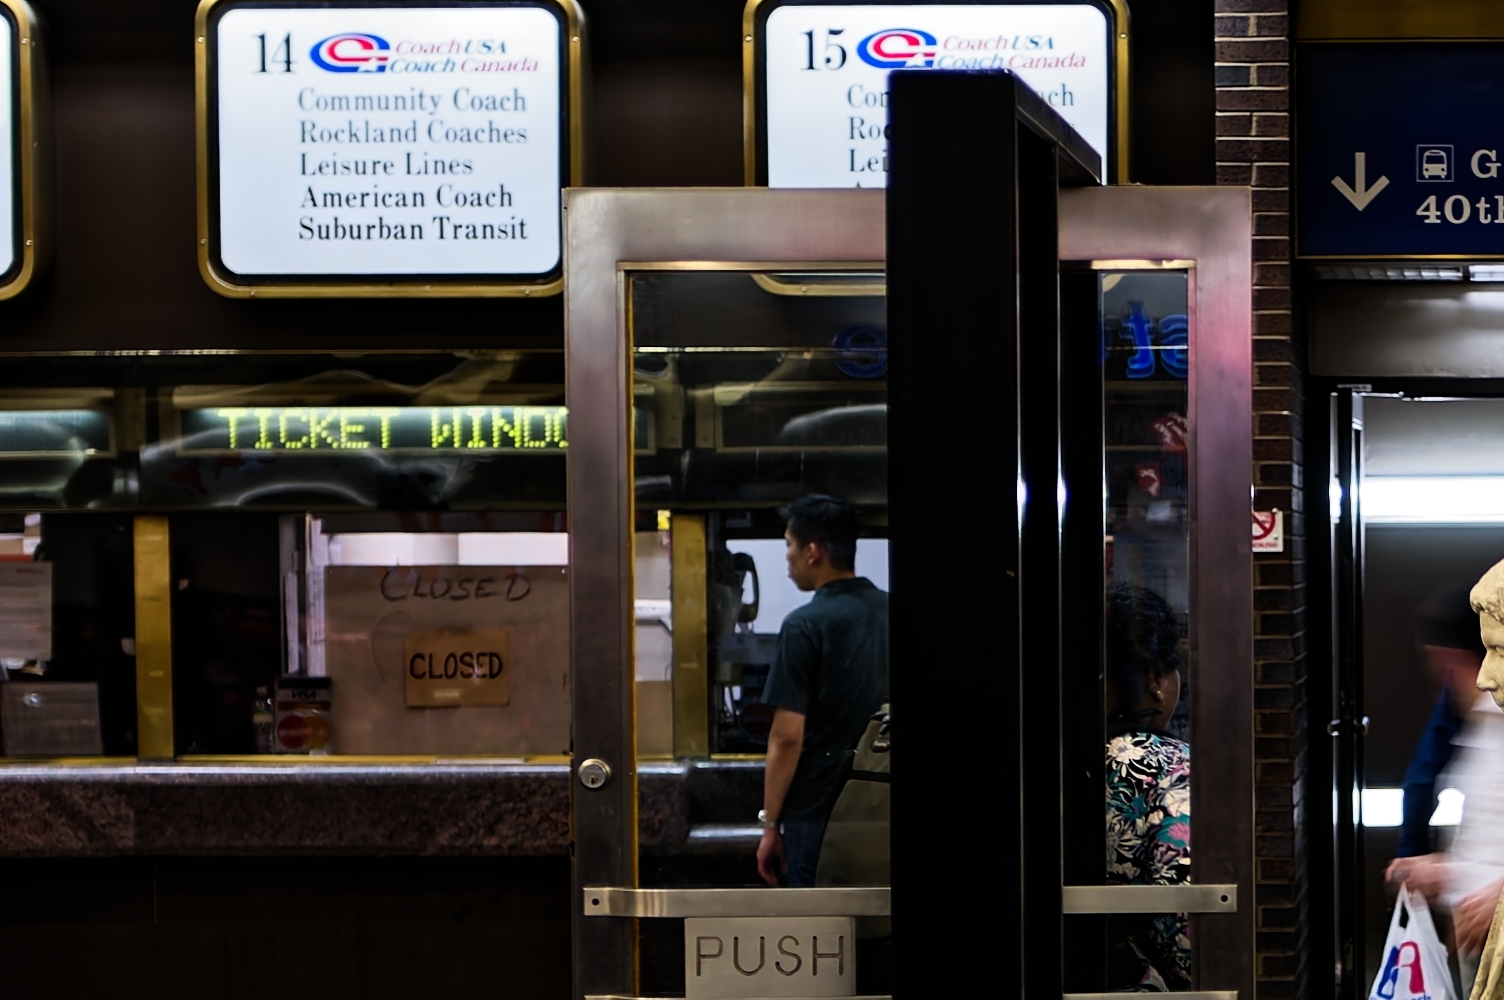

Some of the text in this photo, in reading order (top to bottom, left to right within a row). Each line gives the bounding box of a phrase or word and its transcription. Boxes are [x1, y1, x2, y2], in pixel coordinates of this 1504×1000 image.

[252, 32, 298, 74] 14
[395, 39, 508, 54] Coach USA
[800, 28, 847, 71] 15
[943, 34, 1055, 51] Coach USA
[389, 57, 539, 73] Coach Canada
[937, 53, 1086, 69] Coach Canada
[298, 87, 527, 115] Community Coach
[300, 119, 528, 143] Rockland Coaches
[301, 152, 474, 176] Leisure Lines
[301, 184, 513, 208] American Coach
[299, 216, 529, 241] Suburban Transit
[218, 408, 400, 449] TICKET
[381, 569, 532, 602] CLOSED
[409, 652, 503, 680] CLOSED
[696, 935, 845, 976] PUSH
